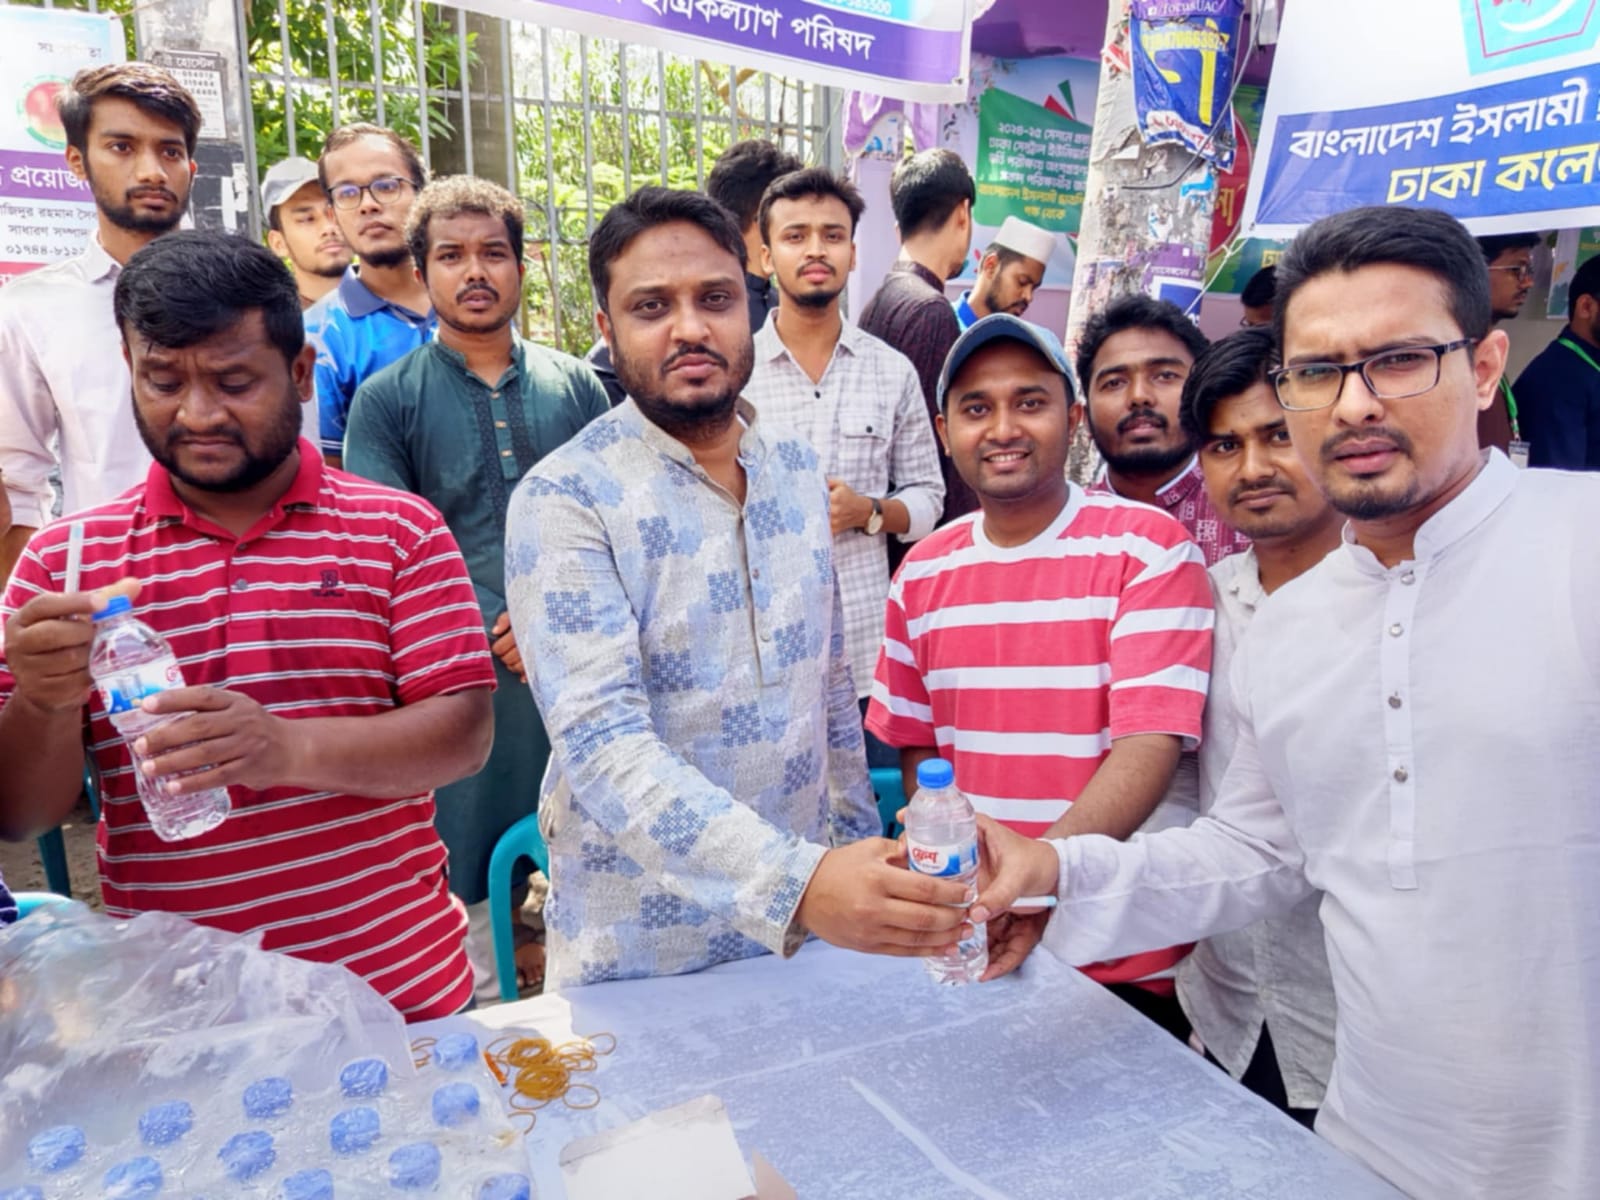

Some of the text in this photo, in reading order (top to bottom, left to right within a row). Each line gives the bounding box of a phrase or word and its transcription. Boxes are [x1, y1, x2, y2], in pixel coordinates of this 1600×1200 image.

[790, 13, 875, 60] পরিষদ
[1288, 116, 1443, 160] বাংলাদেশ
[1449, 77, 1589, 145] ইসলামী
[10, 164, 92, 191] প্রয়োজ
[1386, 141, 1600, 205] ঢাকা কলে
[52, 226, 89, 238] সম্পাদ
